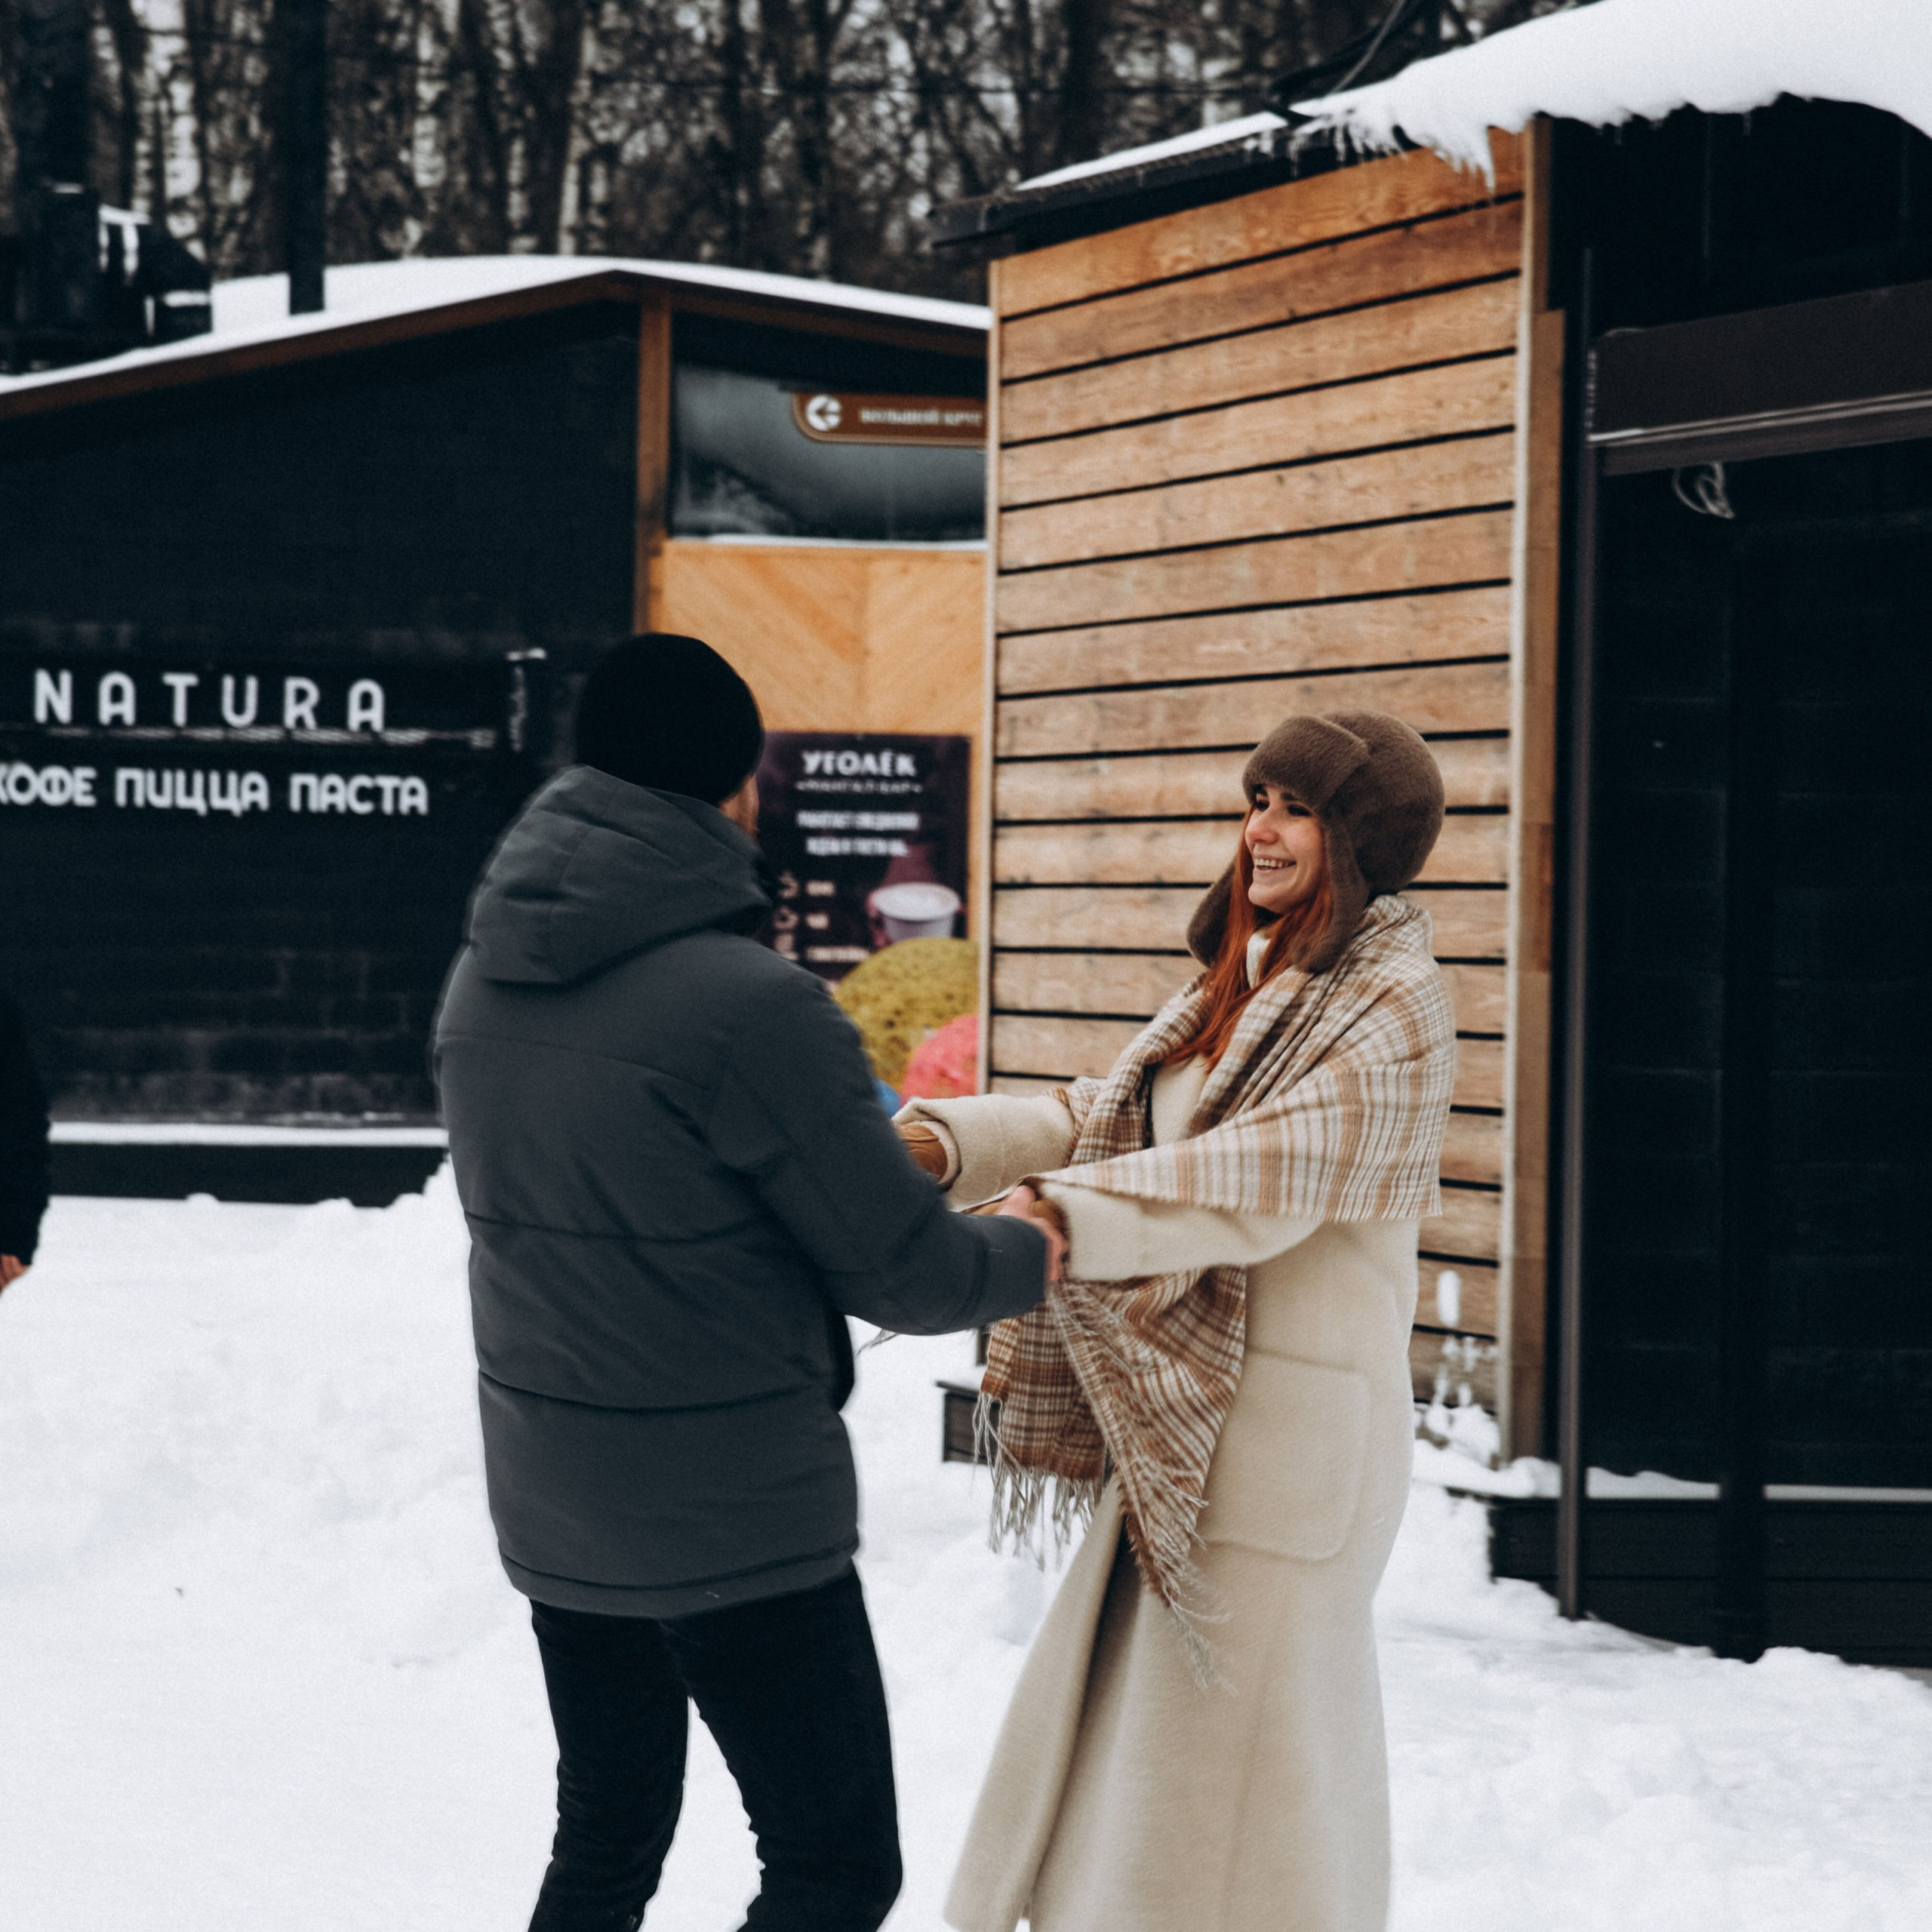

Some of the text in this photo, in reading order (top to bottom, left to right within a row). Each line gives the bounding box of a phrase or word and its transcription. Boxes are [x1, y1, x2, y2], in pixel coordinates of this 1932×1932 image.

[34, 669, 386, 732] NATURA
[115, 767, 269, 817] ПИЦЦА
[289, 774, 429, 815] ПАСТА
